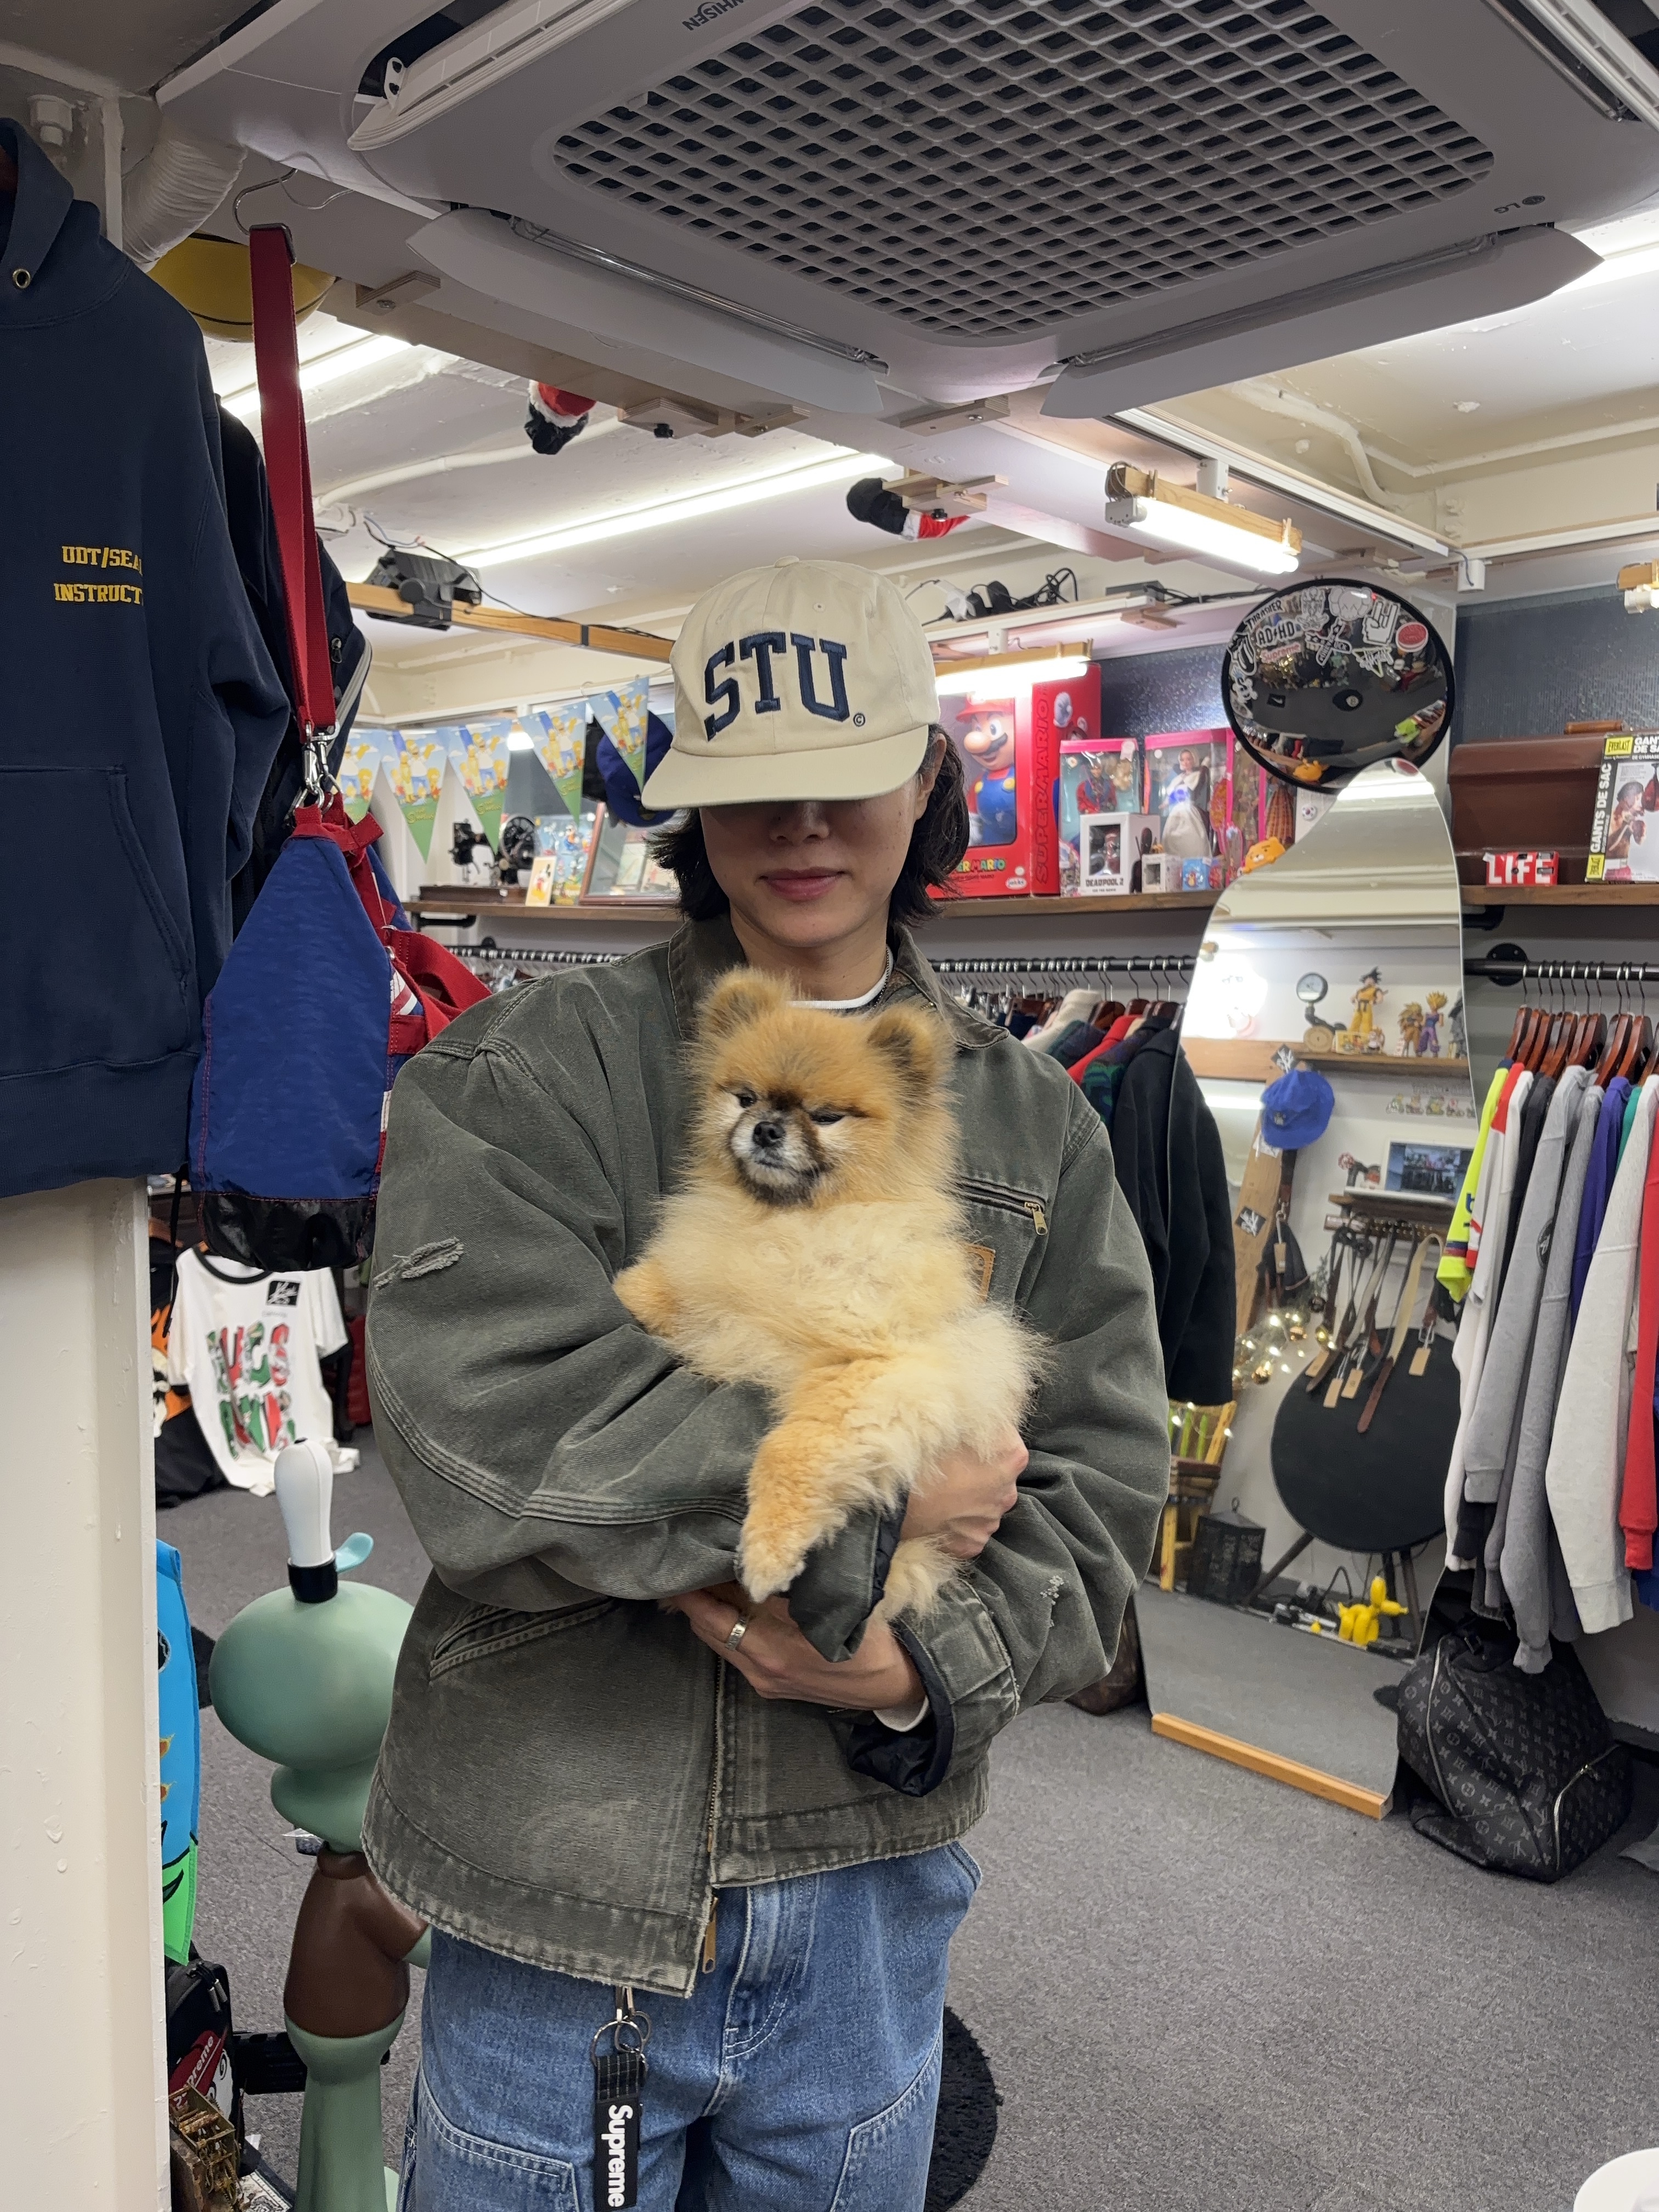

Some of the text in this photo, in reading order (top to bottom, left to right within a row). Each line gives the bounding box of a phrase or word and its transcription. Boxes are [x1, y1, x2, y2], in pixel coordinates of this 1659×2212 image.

[1494, 202, 1521, 213] LG
[61, 545, 143, 576] UDT/SEA
[53, 583, 143, 606] INSTRUCT
[704, 631, 850, 742] STU
[1607, 740, 1630, 752] EVERLAST
[1634, 737, 1659, 746] GAN
[1599, 762, 1612, 789] SAC
[1596, 791, 1608, 809] DE
[1590, 809, 1606, 853] GANTS
[1488, 854, 1552, 884] LIFE
[1086, 878, 1118, 887] DEADPOOL
[601, 2104, 633, 2207] Supreme
